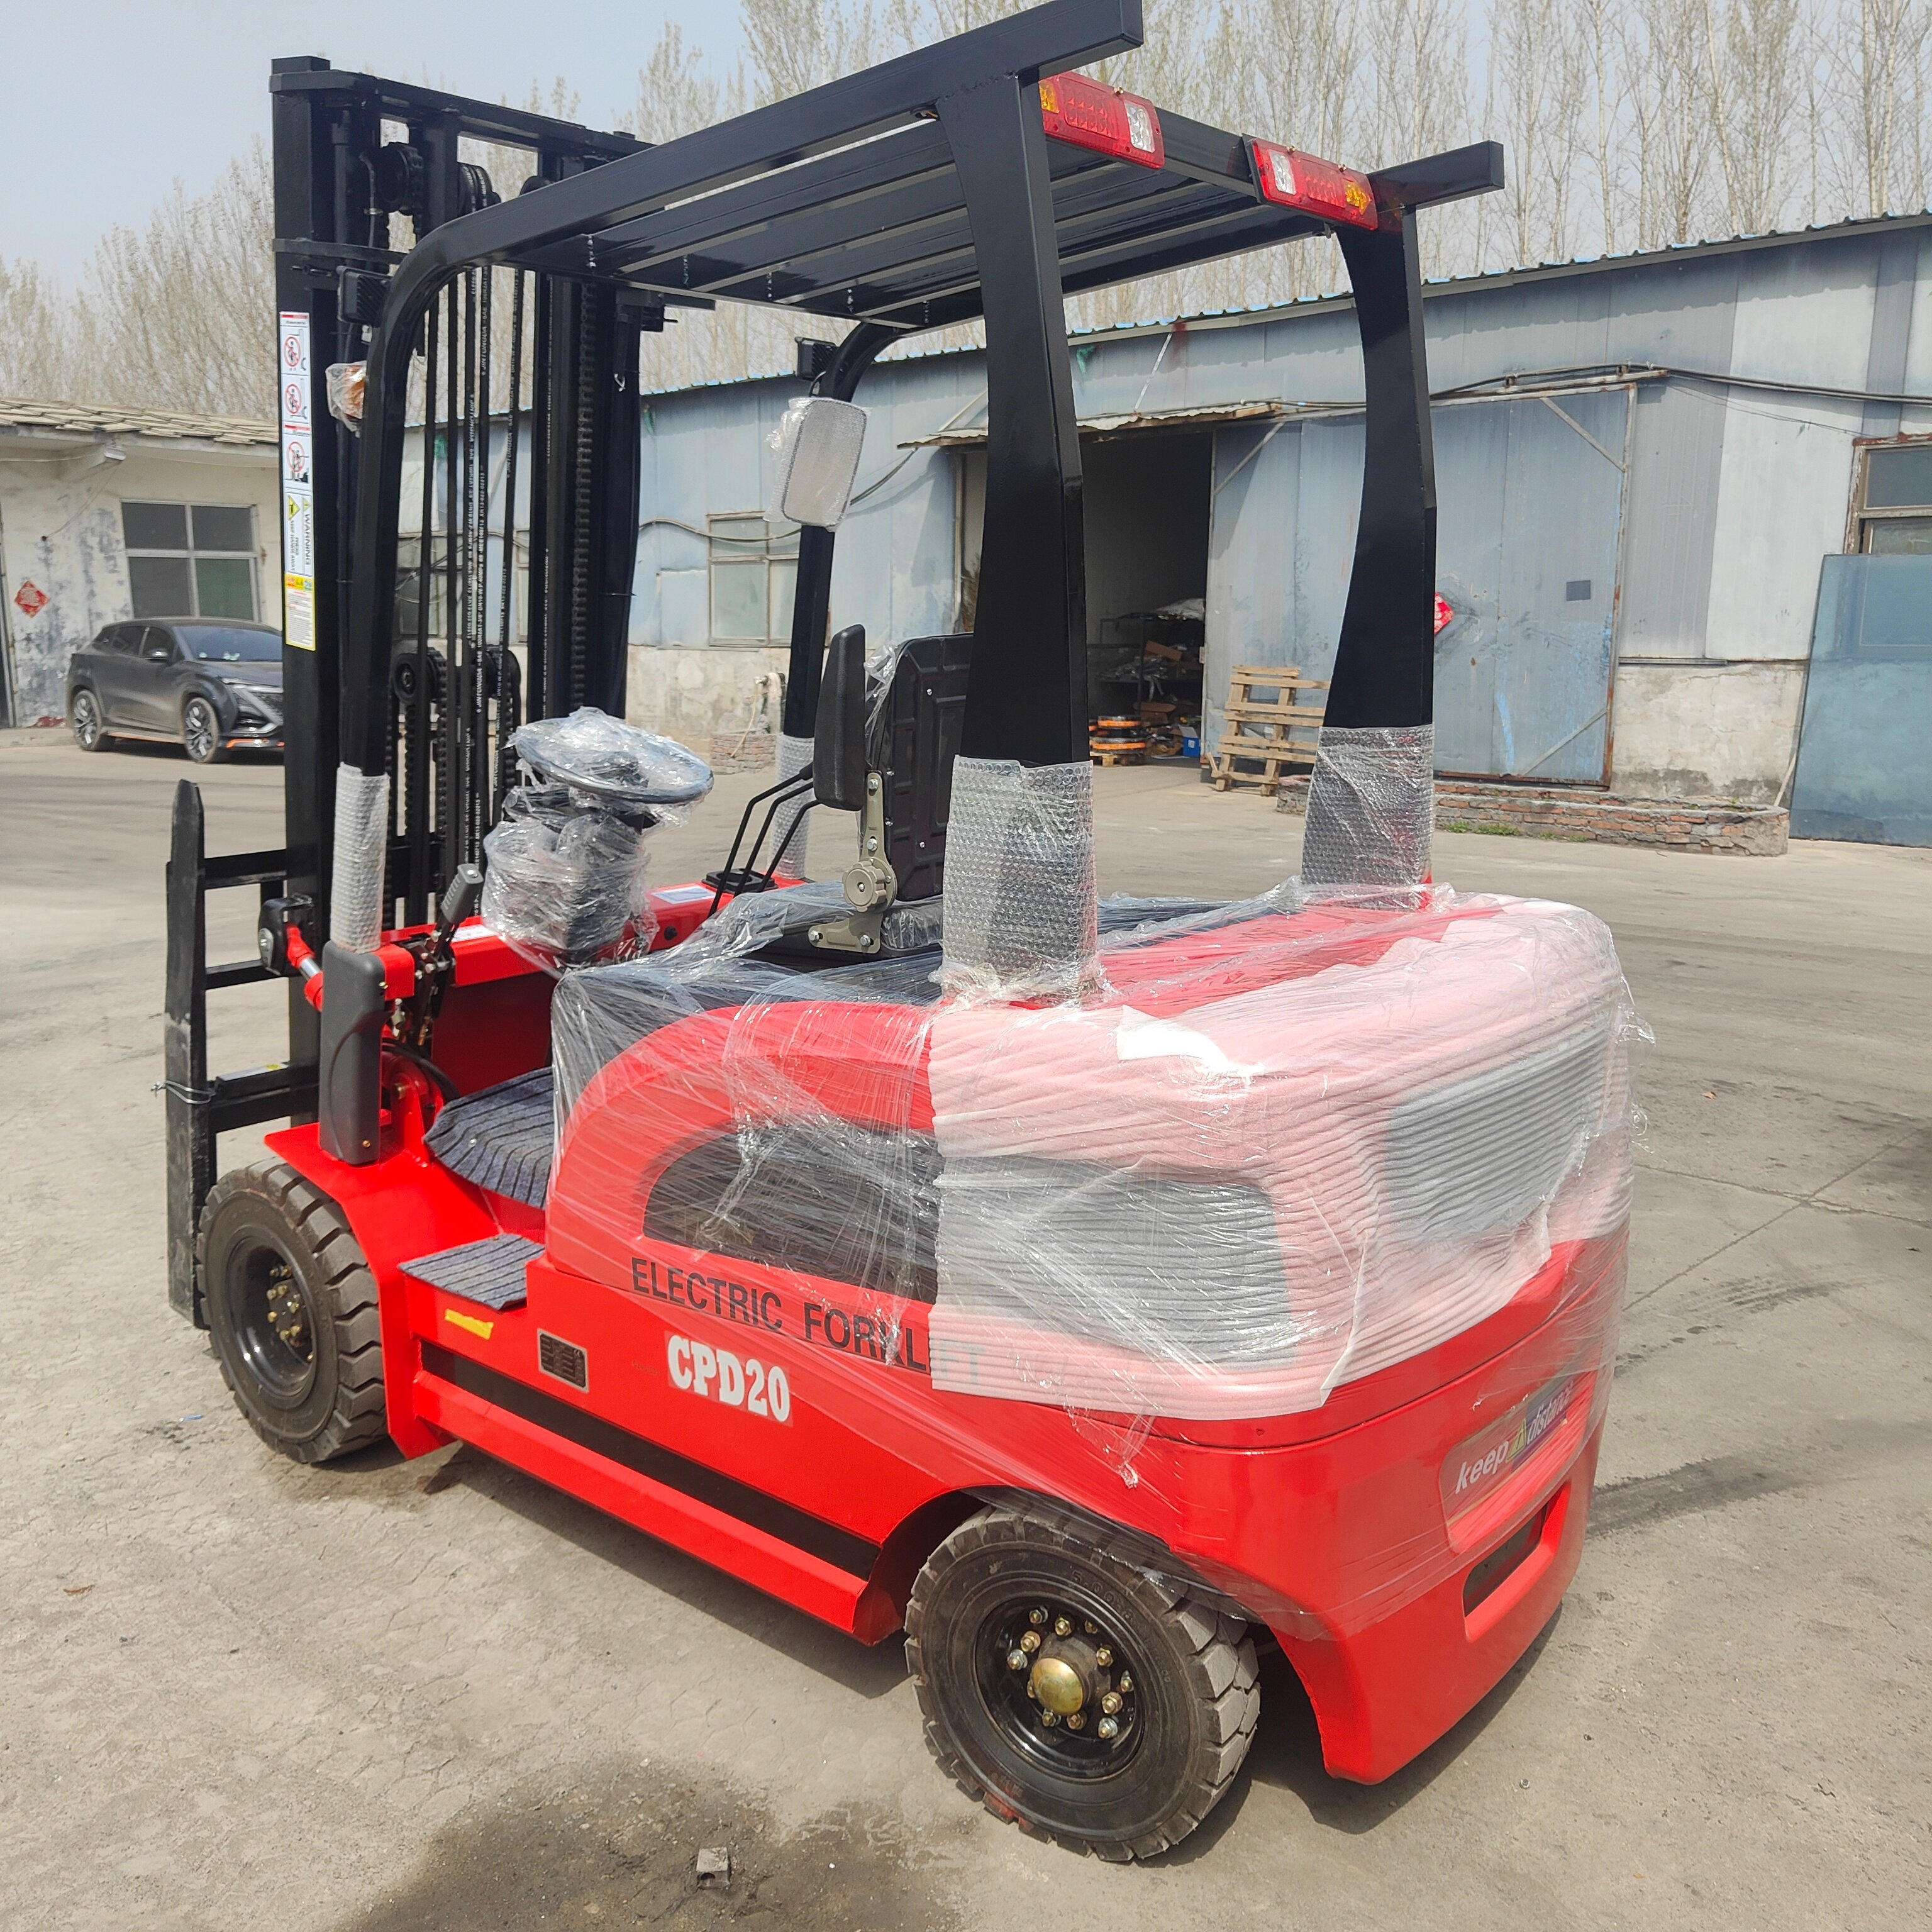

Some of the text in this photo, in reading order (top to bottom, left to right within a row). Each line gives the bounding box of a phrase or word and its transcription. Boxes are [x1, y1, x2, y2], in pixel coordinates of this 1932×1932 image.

[631, 1257, 783, 1330] ELECTRIC
[667, 1335, 791, 1423] CPD20
[1455, 1380, 1574, 1494] keep distance
